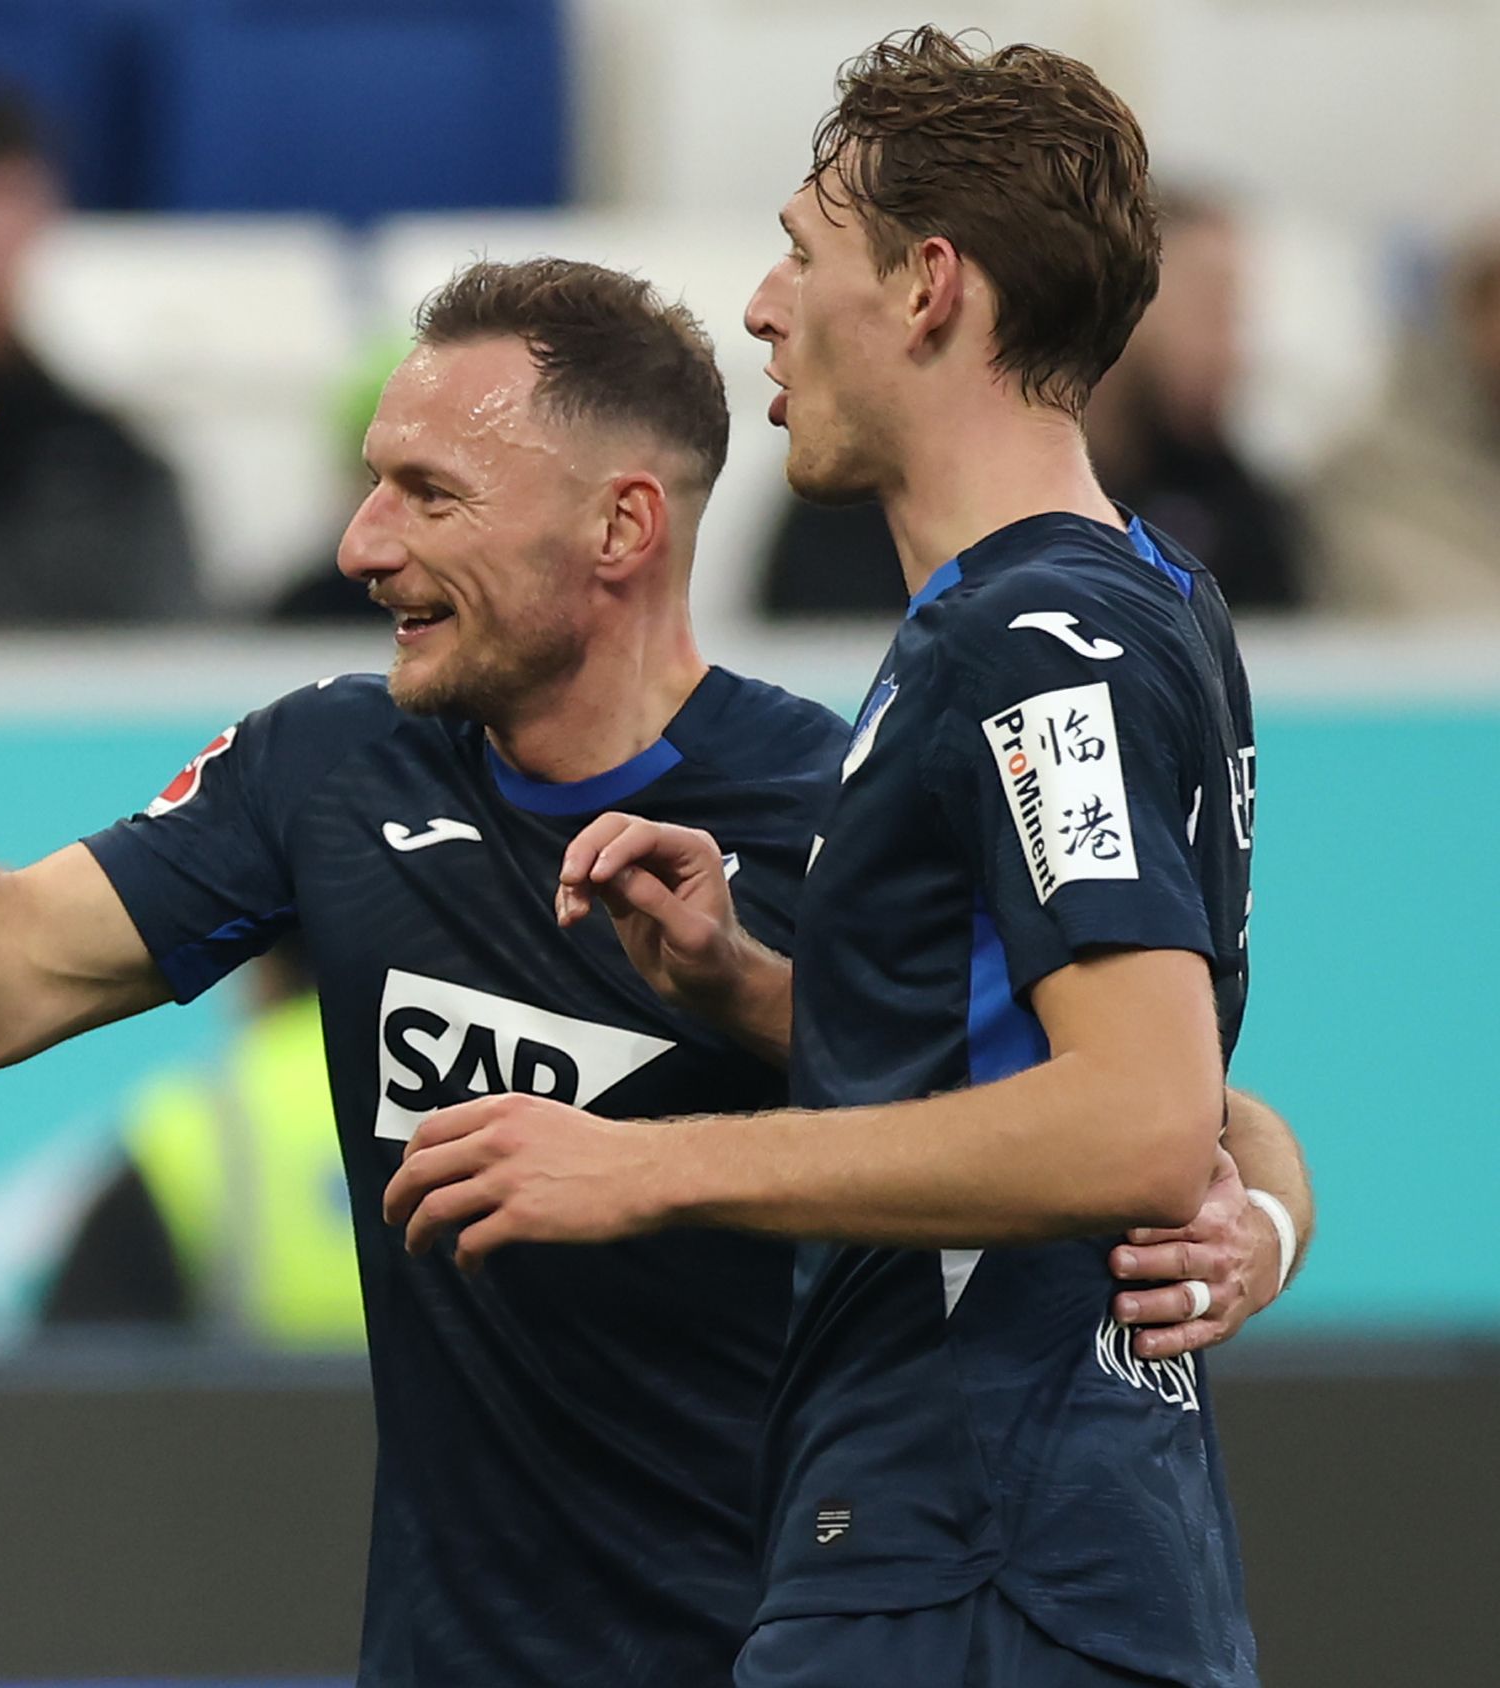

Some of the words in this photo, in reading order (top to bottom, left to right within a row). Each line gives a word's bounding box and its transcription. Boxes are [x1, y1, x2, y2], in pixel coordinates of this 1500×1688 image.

[995, 709, 1056, 897] ProMinent
[1038, 706, 1122, 861] 临港
[384, 1006, 579, 1112] SAP
